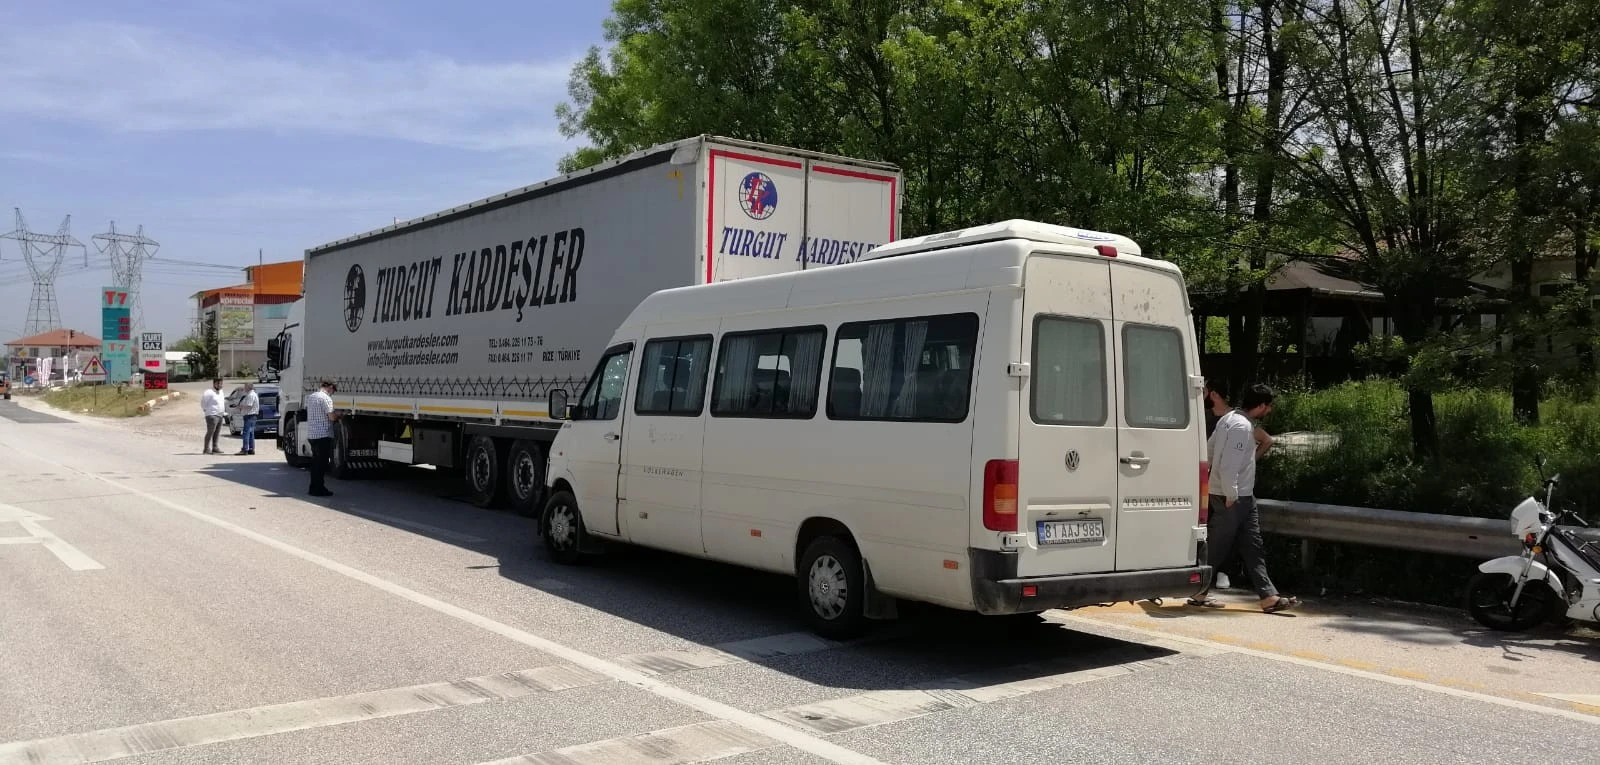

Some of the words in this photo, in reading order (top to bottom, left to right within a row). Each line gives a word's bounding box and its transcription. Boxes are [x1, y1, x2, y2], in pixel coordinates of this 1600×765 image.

[719, 226, 787, 260] TURGUT
[372, 255, 442, 323] TURGUT
[445, 227, 586, 322] KARDEŞLER
[143, 333, 161, 341] YURT
[143, 342, 161, 350] GAZ
[367, 333, 459, 353] www.turgutkardesler.com
[367, 349, 459, 369] info@turgutkardesler.com
[1125, 497, 1190, 507] VOLKSWAGEN
[1045, 523, 1058, 538] 81
[1061, 523, 1080, 538] AAJ
[1082, 522, 1102, 537] 985
